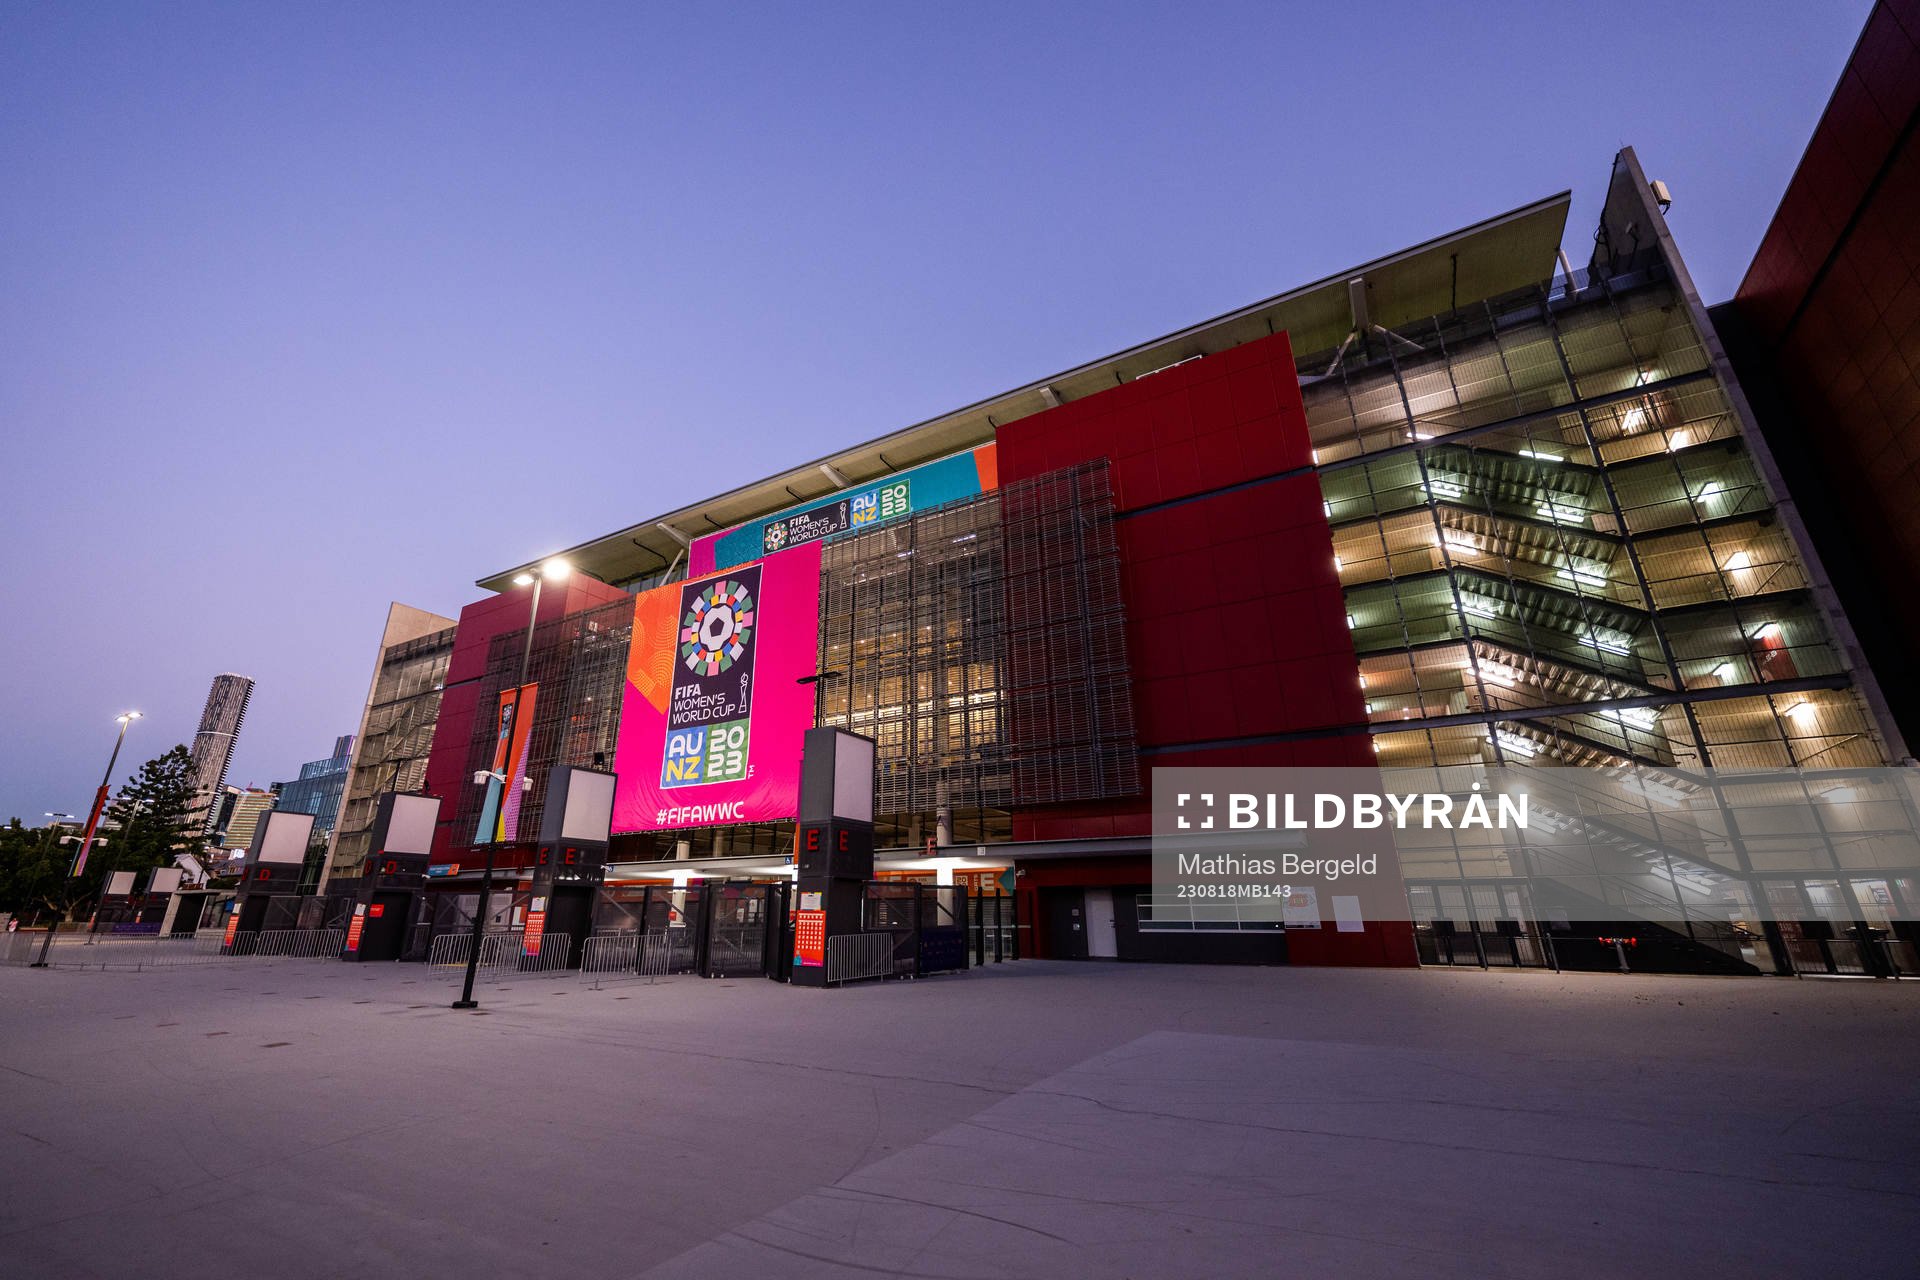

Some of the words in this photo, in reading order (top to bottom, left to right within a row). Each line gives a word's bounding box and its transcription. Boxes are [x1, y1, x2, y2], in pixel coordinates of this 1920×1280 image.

[853, 493, 876, 511] AU
[881, 484, 906, 502] 20
[853, 507, 877, 525] NZ
[882, 497, 906, 516] 23
[789, 517, 829, 535] WOMEN'S
[790, 514, 810, 526] FIFA
[789, 528, 820, 543] WORLD
[820, 523, 838, 536] CUP
[674, 692, 726, 712] WOMEN'S
[675, 684, 701, 700] FIFA
[673, 707, 711, 725] WORLD
[712, 703, 736, 718] CUP
[668, 732, 702, 757] AU
[710, 725, 745, 753] 20
[666, 756, 701, 782] NZ
[707, 750, 743, 777] 23
[656, 801, 744, 825] #FIFAWWC
[807, 829, 819, 850] E
[840, 830, 849, 851] E
[539, 847, 549, 865] E
[565, 847, 577, 865] E
